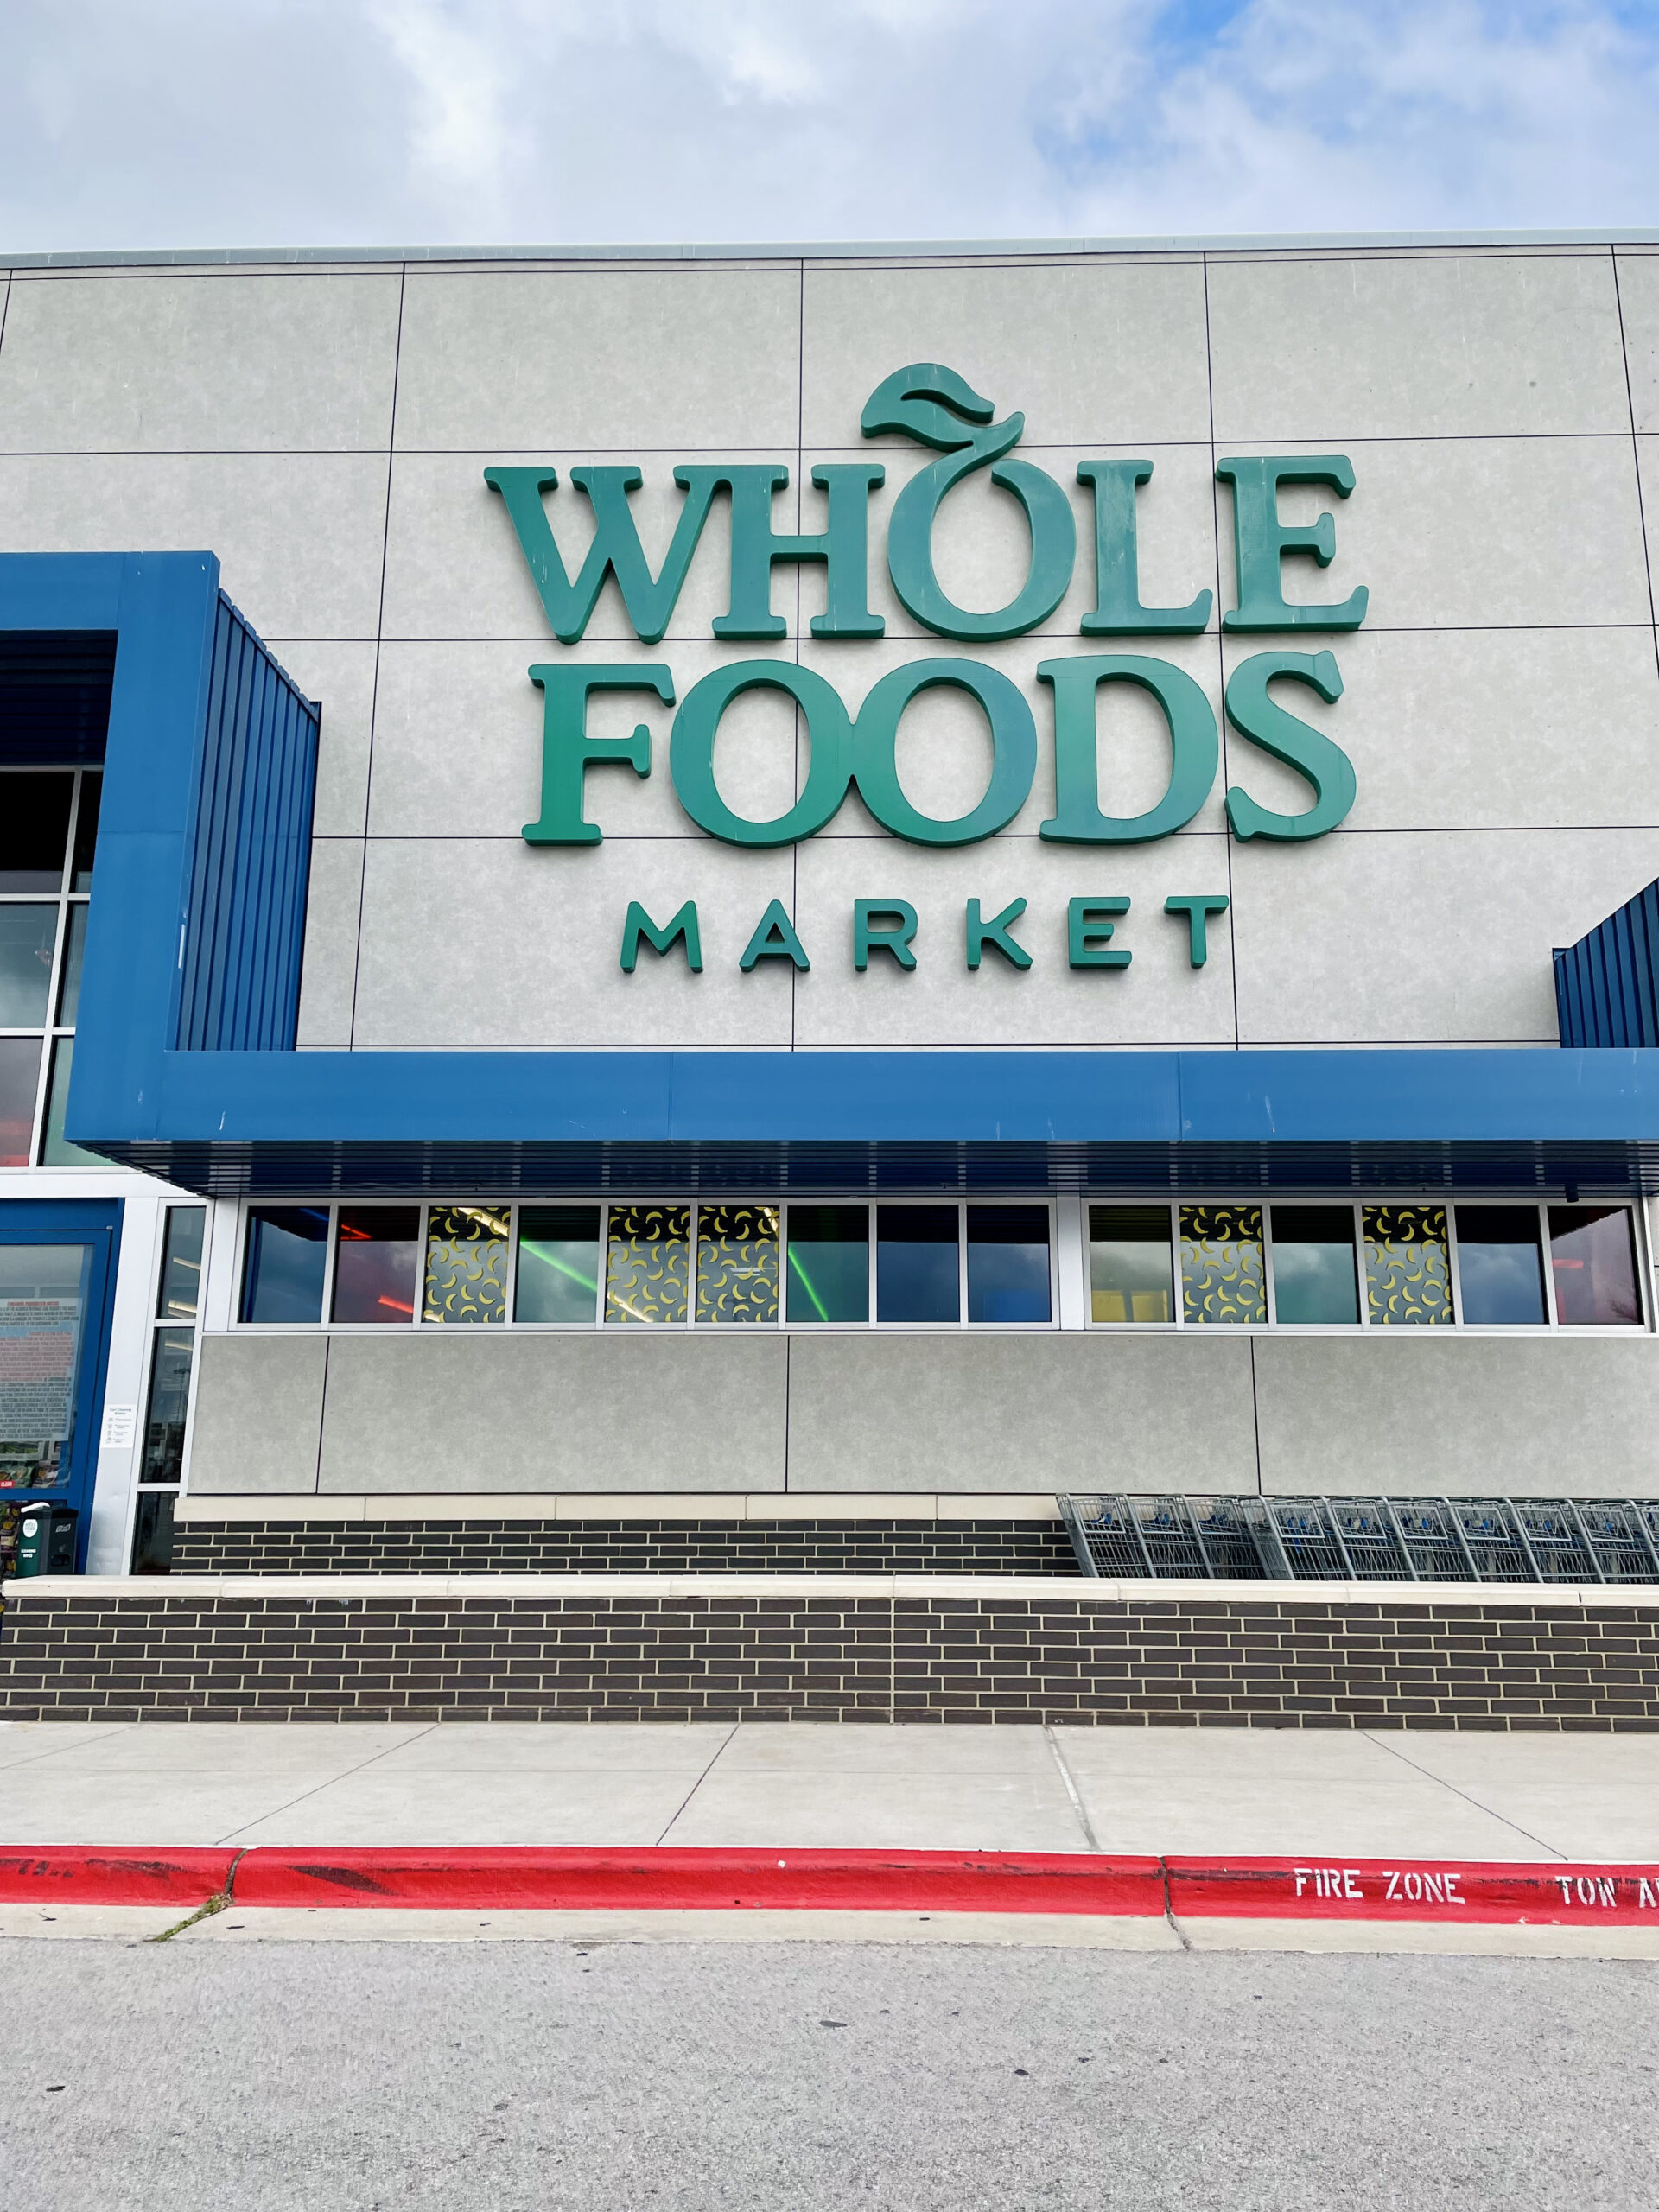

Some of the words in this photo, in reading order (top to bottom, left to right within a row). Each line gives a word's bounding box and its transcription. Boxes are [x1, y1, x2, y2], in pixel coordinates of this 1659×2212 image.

[484, 454, 1369, 645] WHOLE
[522, 650, 1357, 849] FOODS
[620, 895, 1230, 974] MARKET
[1294, 1867, 1364, 1899] FIRE
[1382, 1870, 1466, 1904] ZONE
[1555, 1876, 1618, 1908] TOW
[1639, 1877, 1659, 1909] A
